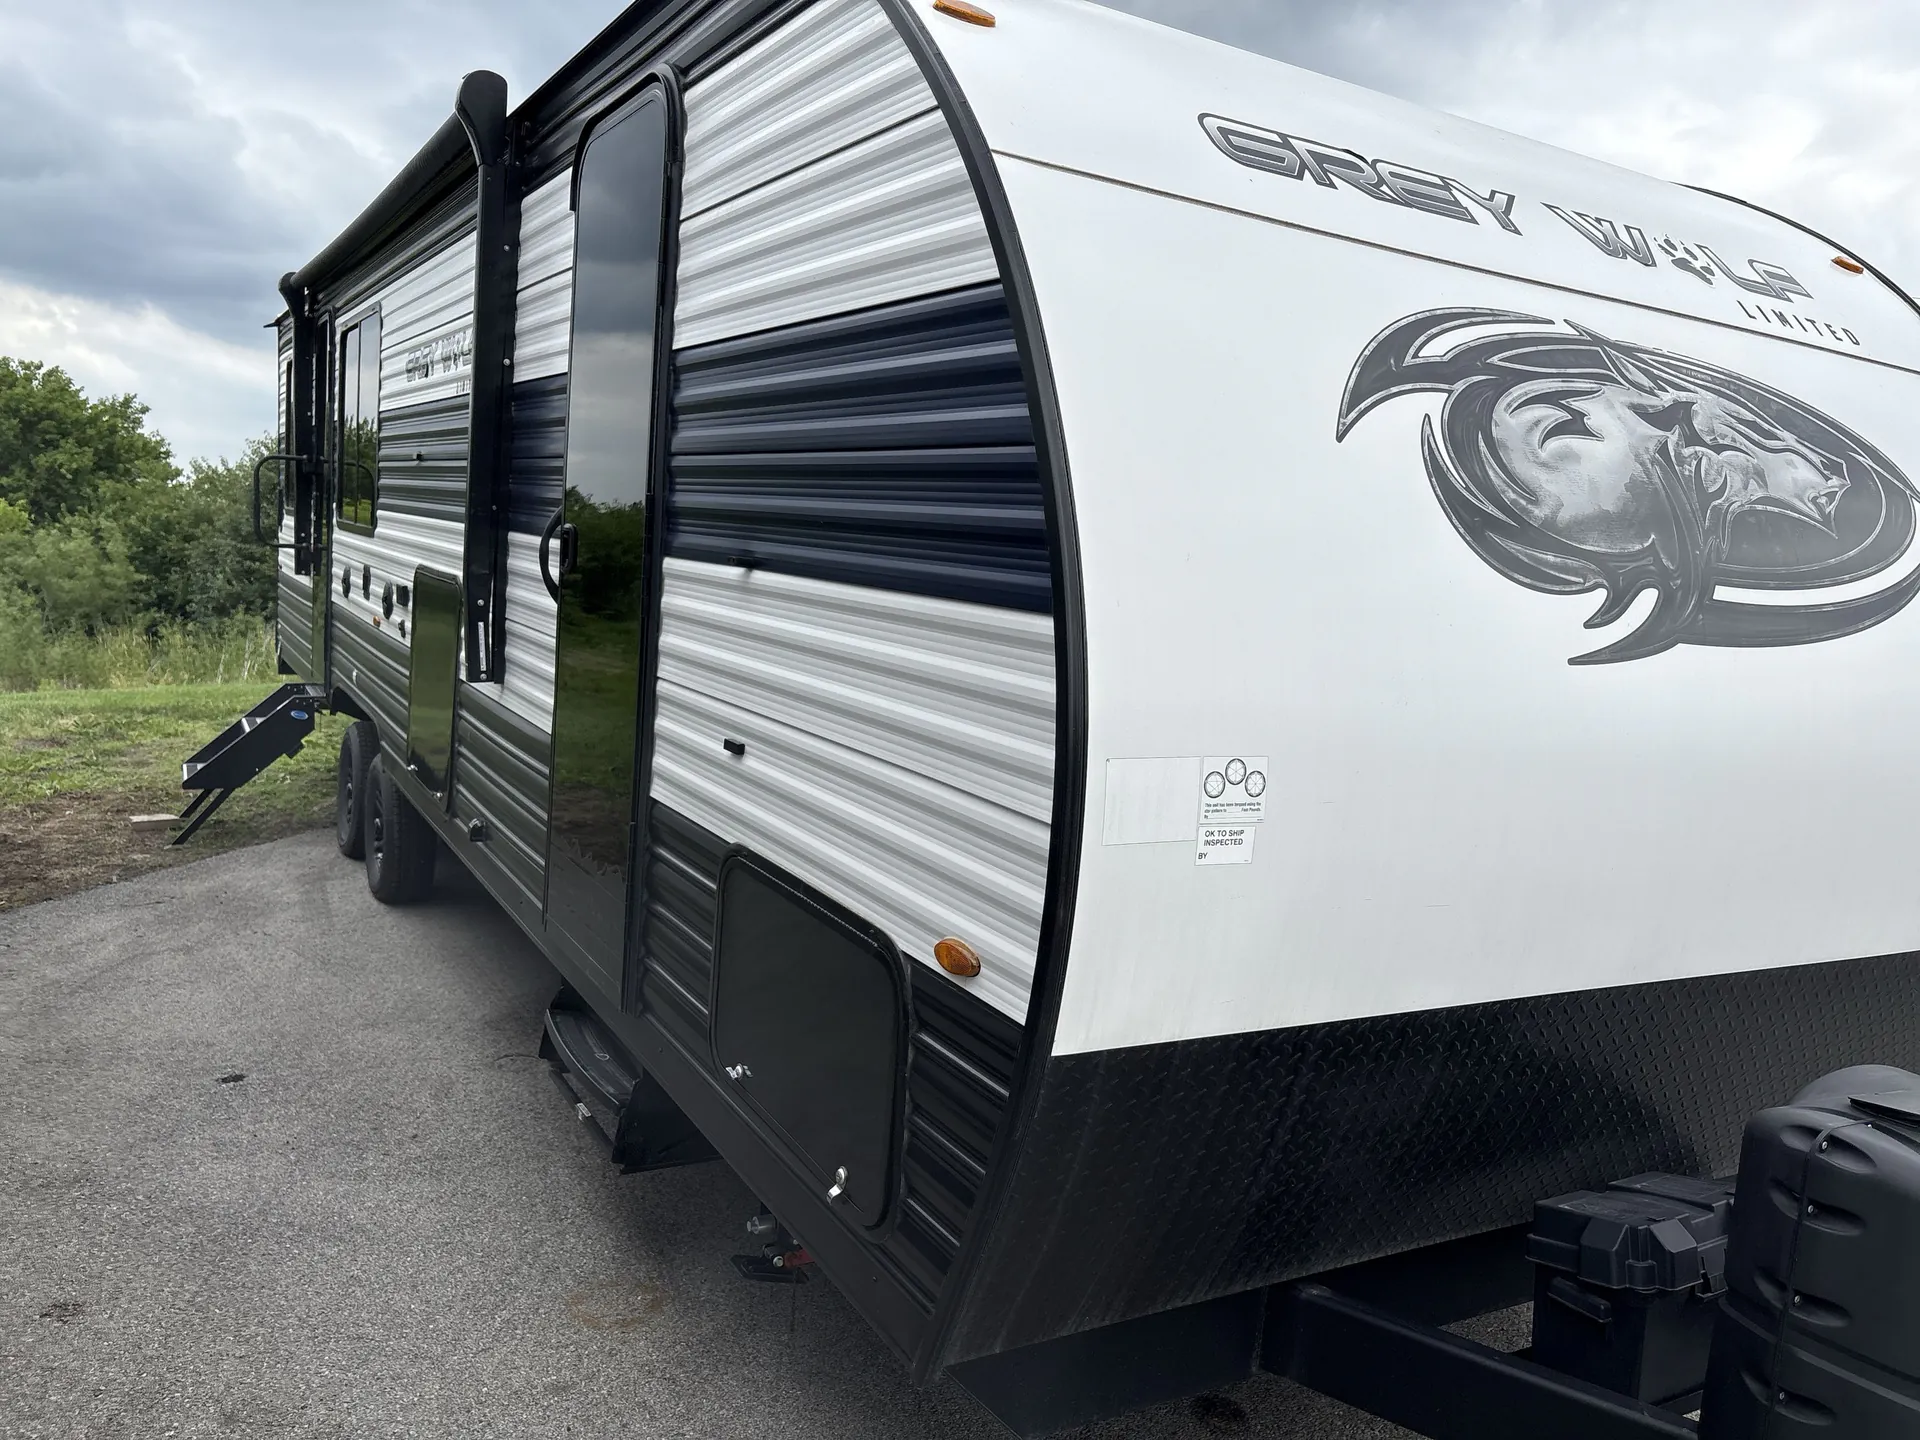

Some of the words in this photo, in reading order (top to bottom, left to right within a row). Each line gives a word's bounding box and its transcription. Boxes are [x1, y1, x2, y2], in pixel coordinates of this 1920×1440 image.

[1197, 112, 1523, 236] GREY
[1736, 300, 1861, 346] LIMITED
[1205, 830, 1215, 838] OK
[1217, 829, 1227, 837] TO
[1228, 829, 1245, 837] SHIP
[1204, 838, 1244, 847] INSPECTED
[1198, 852, 1208, 860] BY
